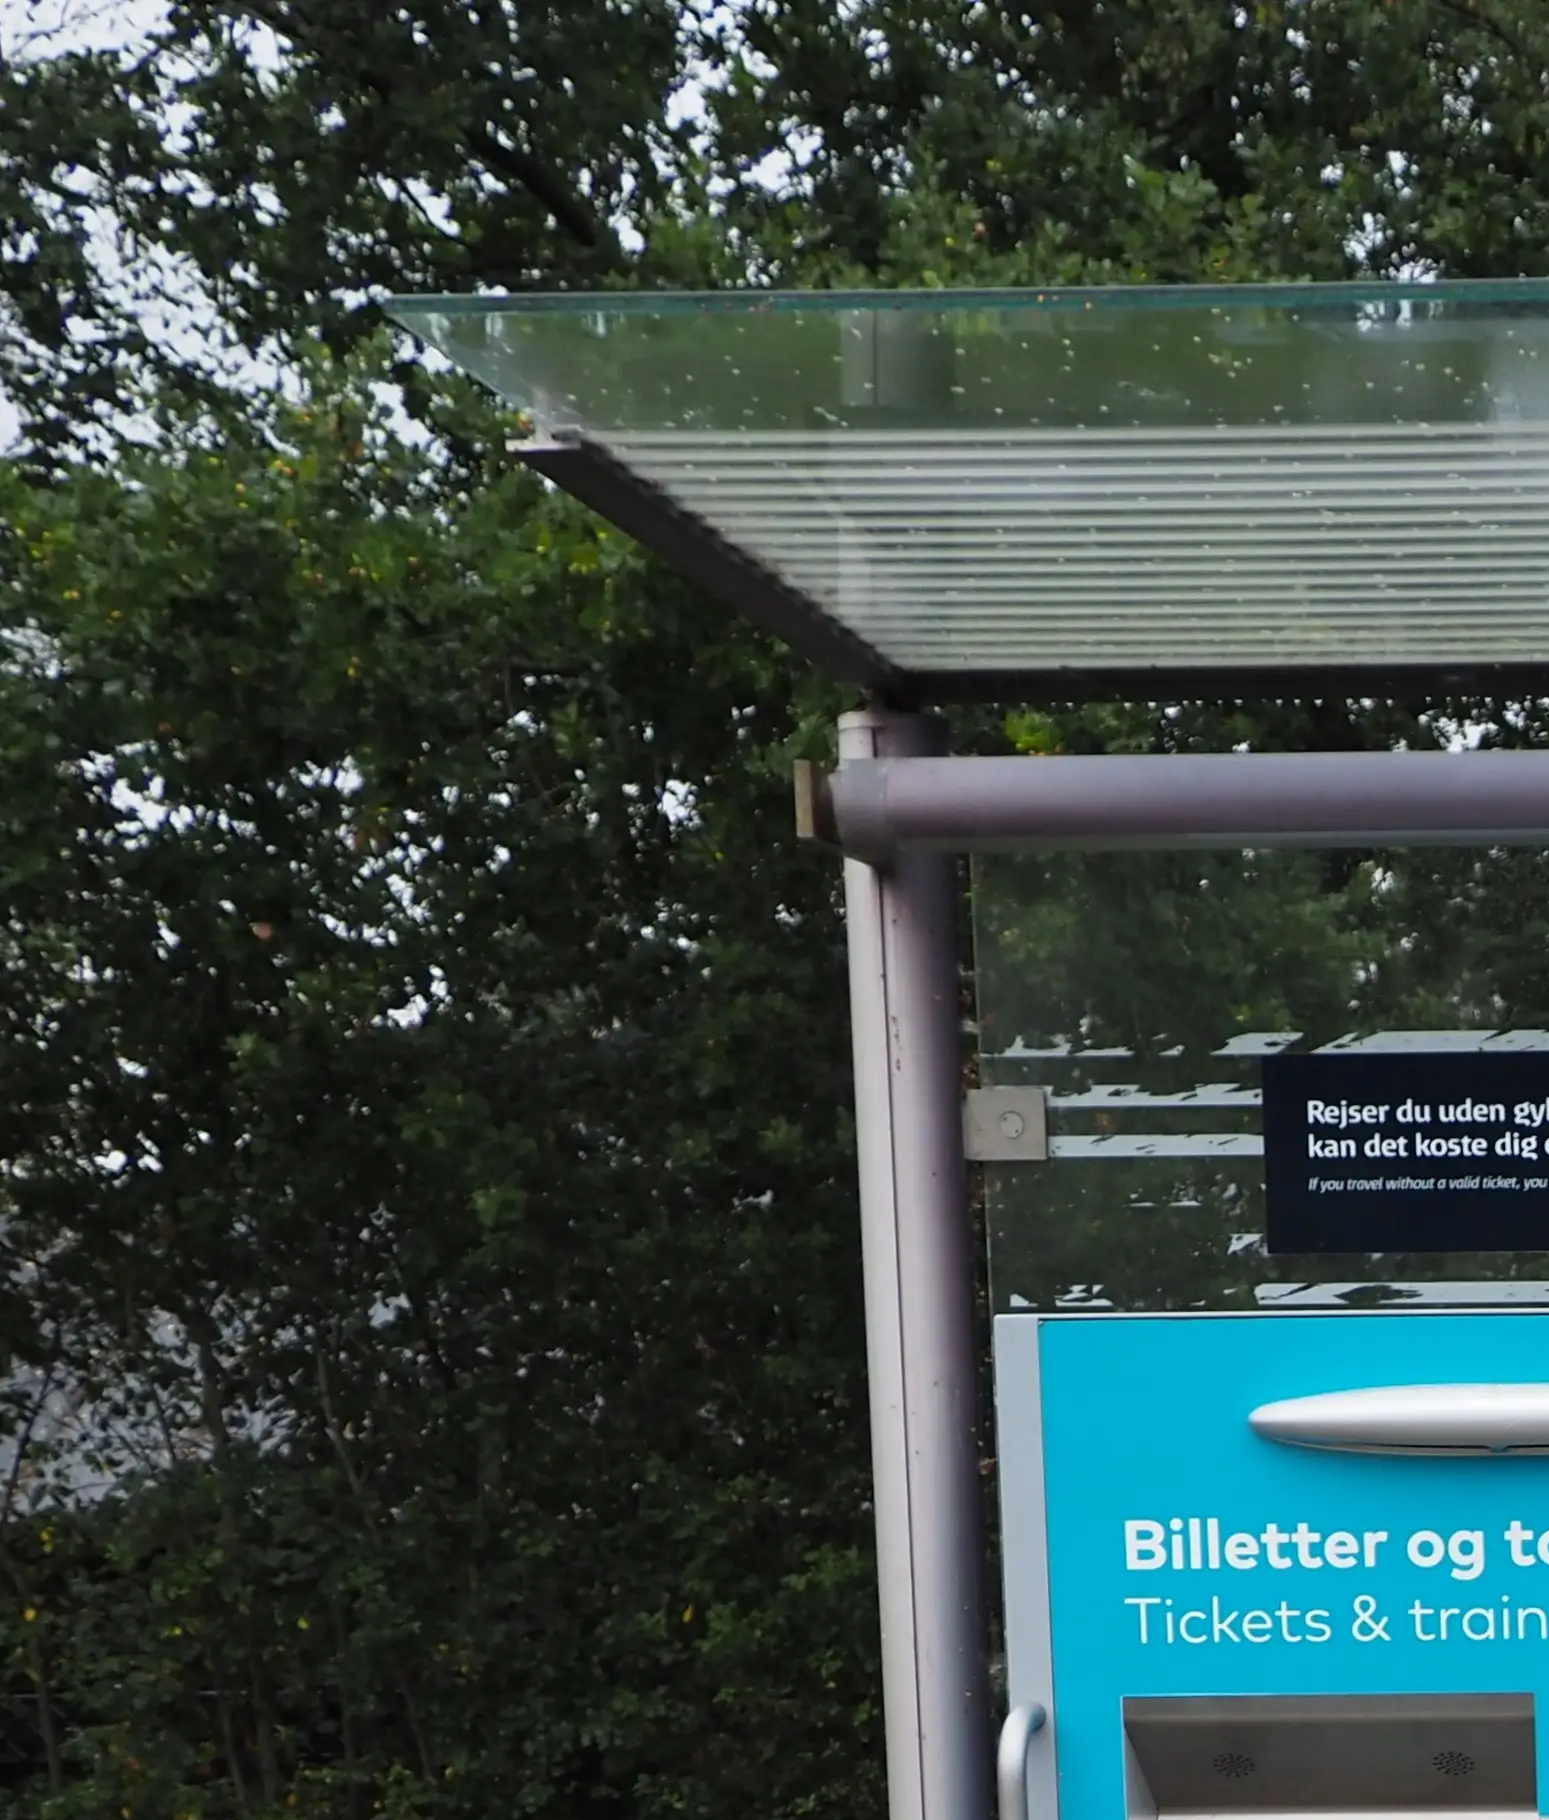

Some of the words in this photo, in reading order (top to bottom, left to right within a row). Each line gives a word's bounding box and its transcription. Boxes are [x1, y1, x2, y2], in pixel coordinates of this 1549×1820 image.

[1306, 1099, 1390, 1129] Rejser
[1395, 1097, 1431, 1123] du
[1438, 1097, 1506, 1123] uden
[1307, 1132, 1357, 1158] kan
[1363, 1132, 1409, 1157] det
[1414, 1131, 1488, 1157] koste
[1493, 1130, 1538, 1161] dig
[1307, 1176, 1319, 1191] If
[1319, 1179, 1345, 1194] you
[1345, 1176, 1384, 1191] travel
[1384, 1175, 1436, 1190] without
[1436, 1178, 1447, 1190] a
[1448, 1175, 1481, 1190] valid
[1481, 1174, 1521, 1190] ticket,
[1522, 1177, 1549, 1192] you
[1123, 1516, 1388, 1570] Billetter
[1406, 1529, 1485, 1581] og
[1123, 1594, 1333, 1644] Tickets
[1351, 1593, 1391, 1642] &
[1407, 1594, 1548, 1641] train
